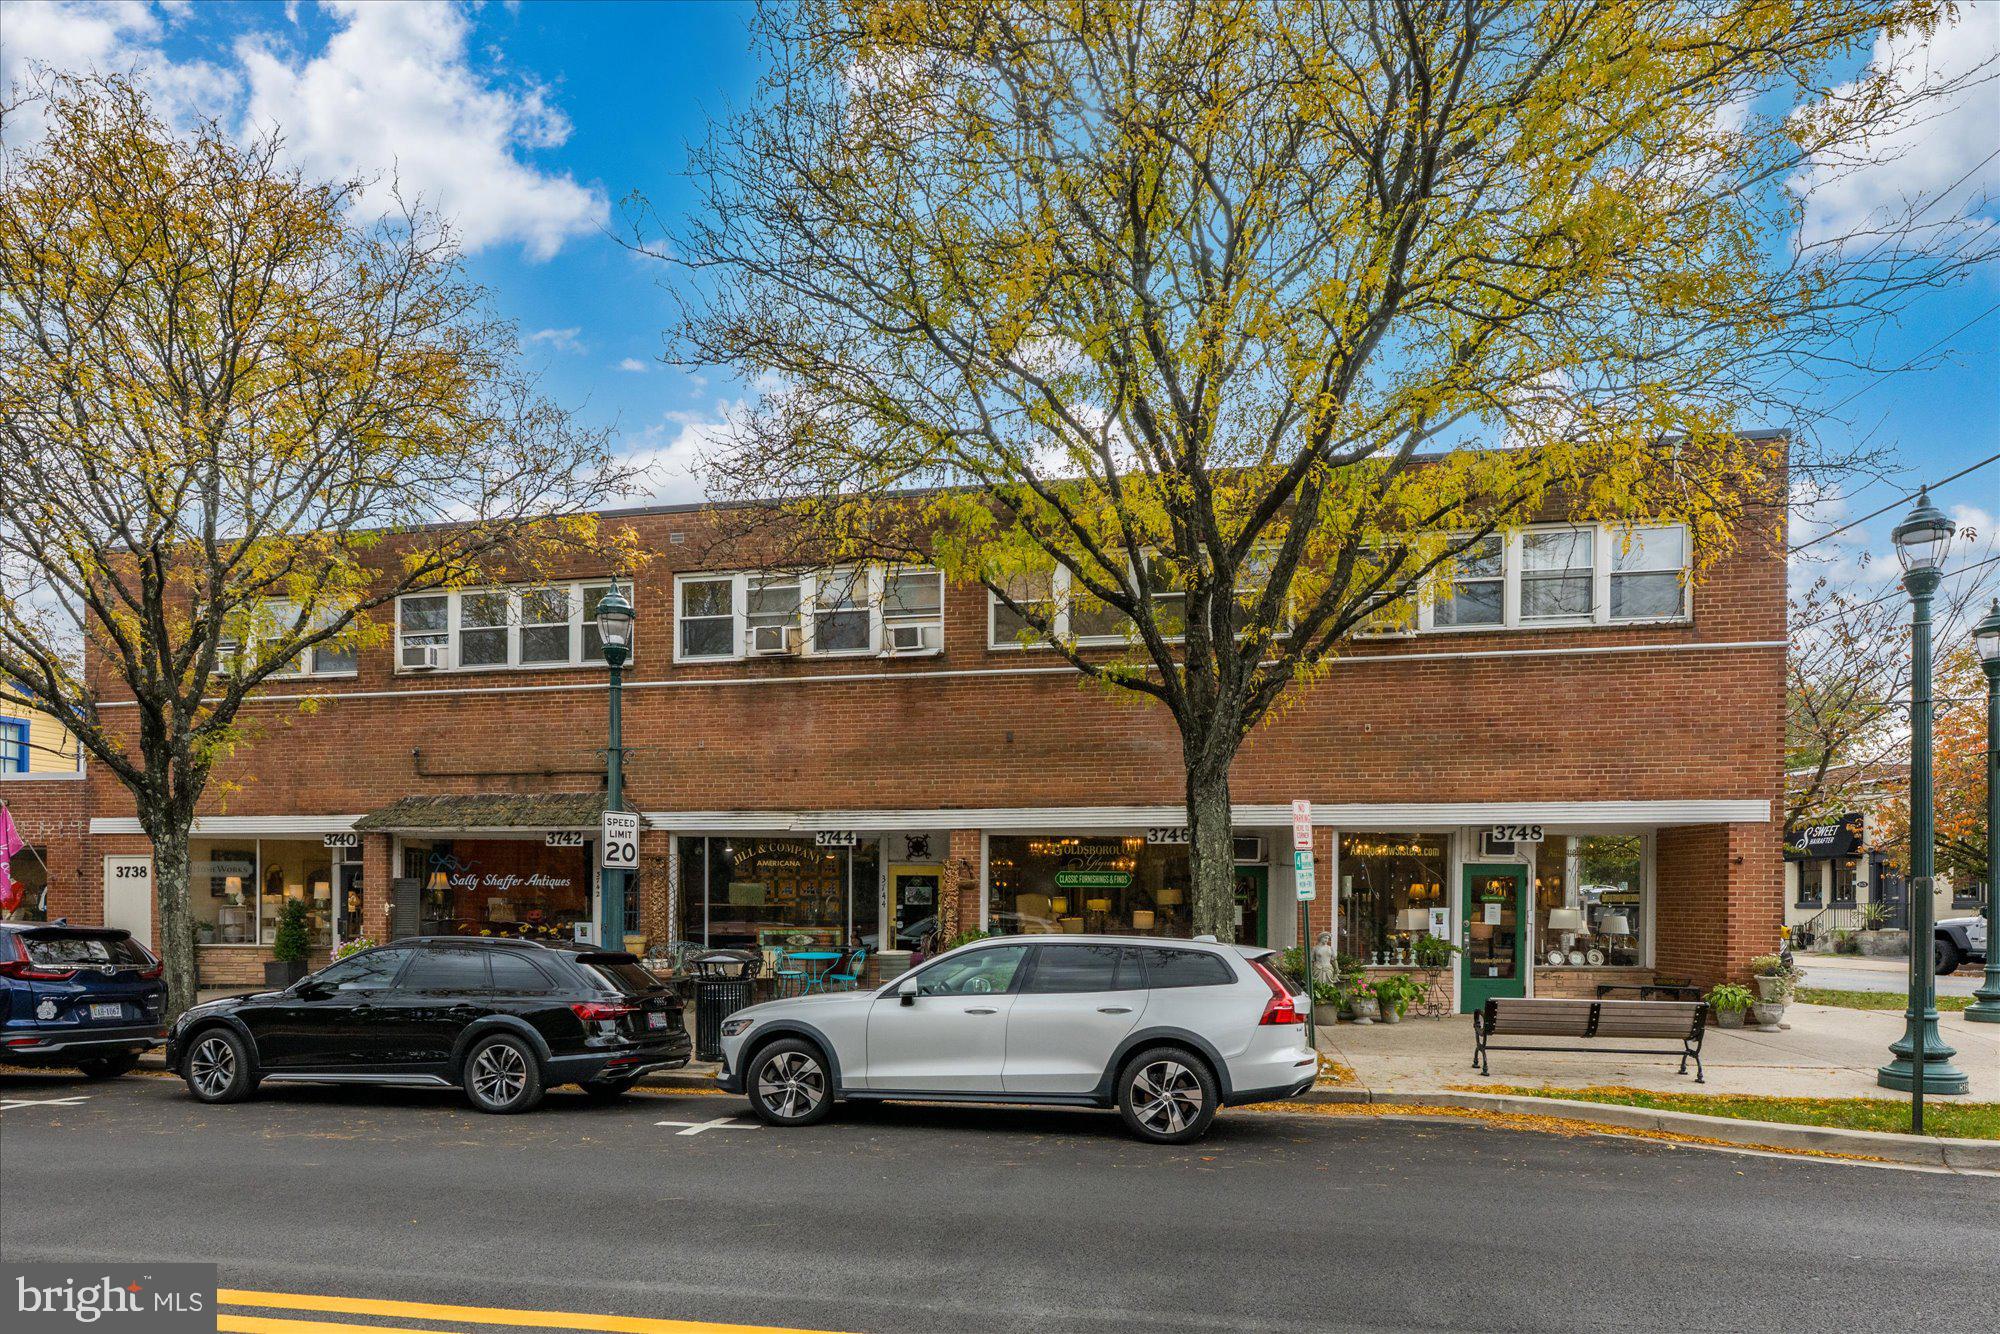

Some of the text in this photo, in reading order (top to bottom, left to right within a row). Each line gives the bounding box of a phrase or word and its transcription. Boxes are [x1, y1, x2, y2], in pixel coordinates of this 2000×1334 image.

[607, 818, 635, 827] SPEED
[1294, 814, 1311, 823] PARKING
[609, 830, 632, 838] LIMIT
[1149, 828, 1189, 842] 3746
[1494, 825, 1542, 840] 3748
[1812, 825, 1840, 837] SWEET
[324, 833, 357, 845] 3740
[546, 831, 582, 844] 3742
[817, 831, 854, 844] 3744
[606, 842, 636, 862] 20
[733, 843, 824, 865] JILL & COMPANY
[116, 866, 147, 878] 3738
[450, 873, 571, 890] Sally Shaffer Antiques
[1060, 875, 1127, 883] CLASSIC FURNISHINGS & FINDS
